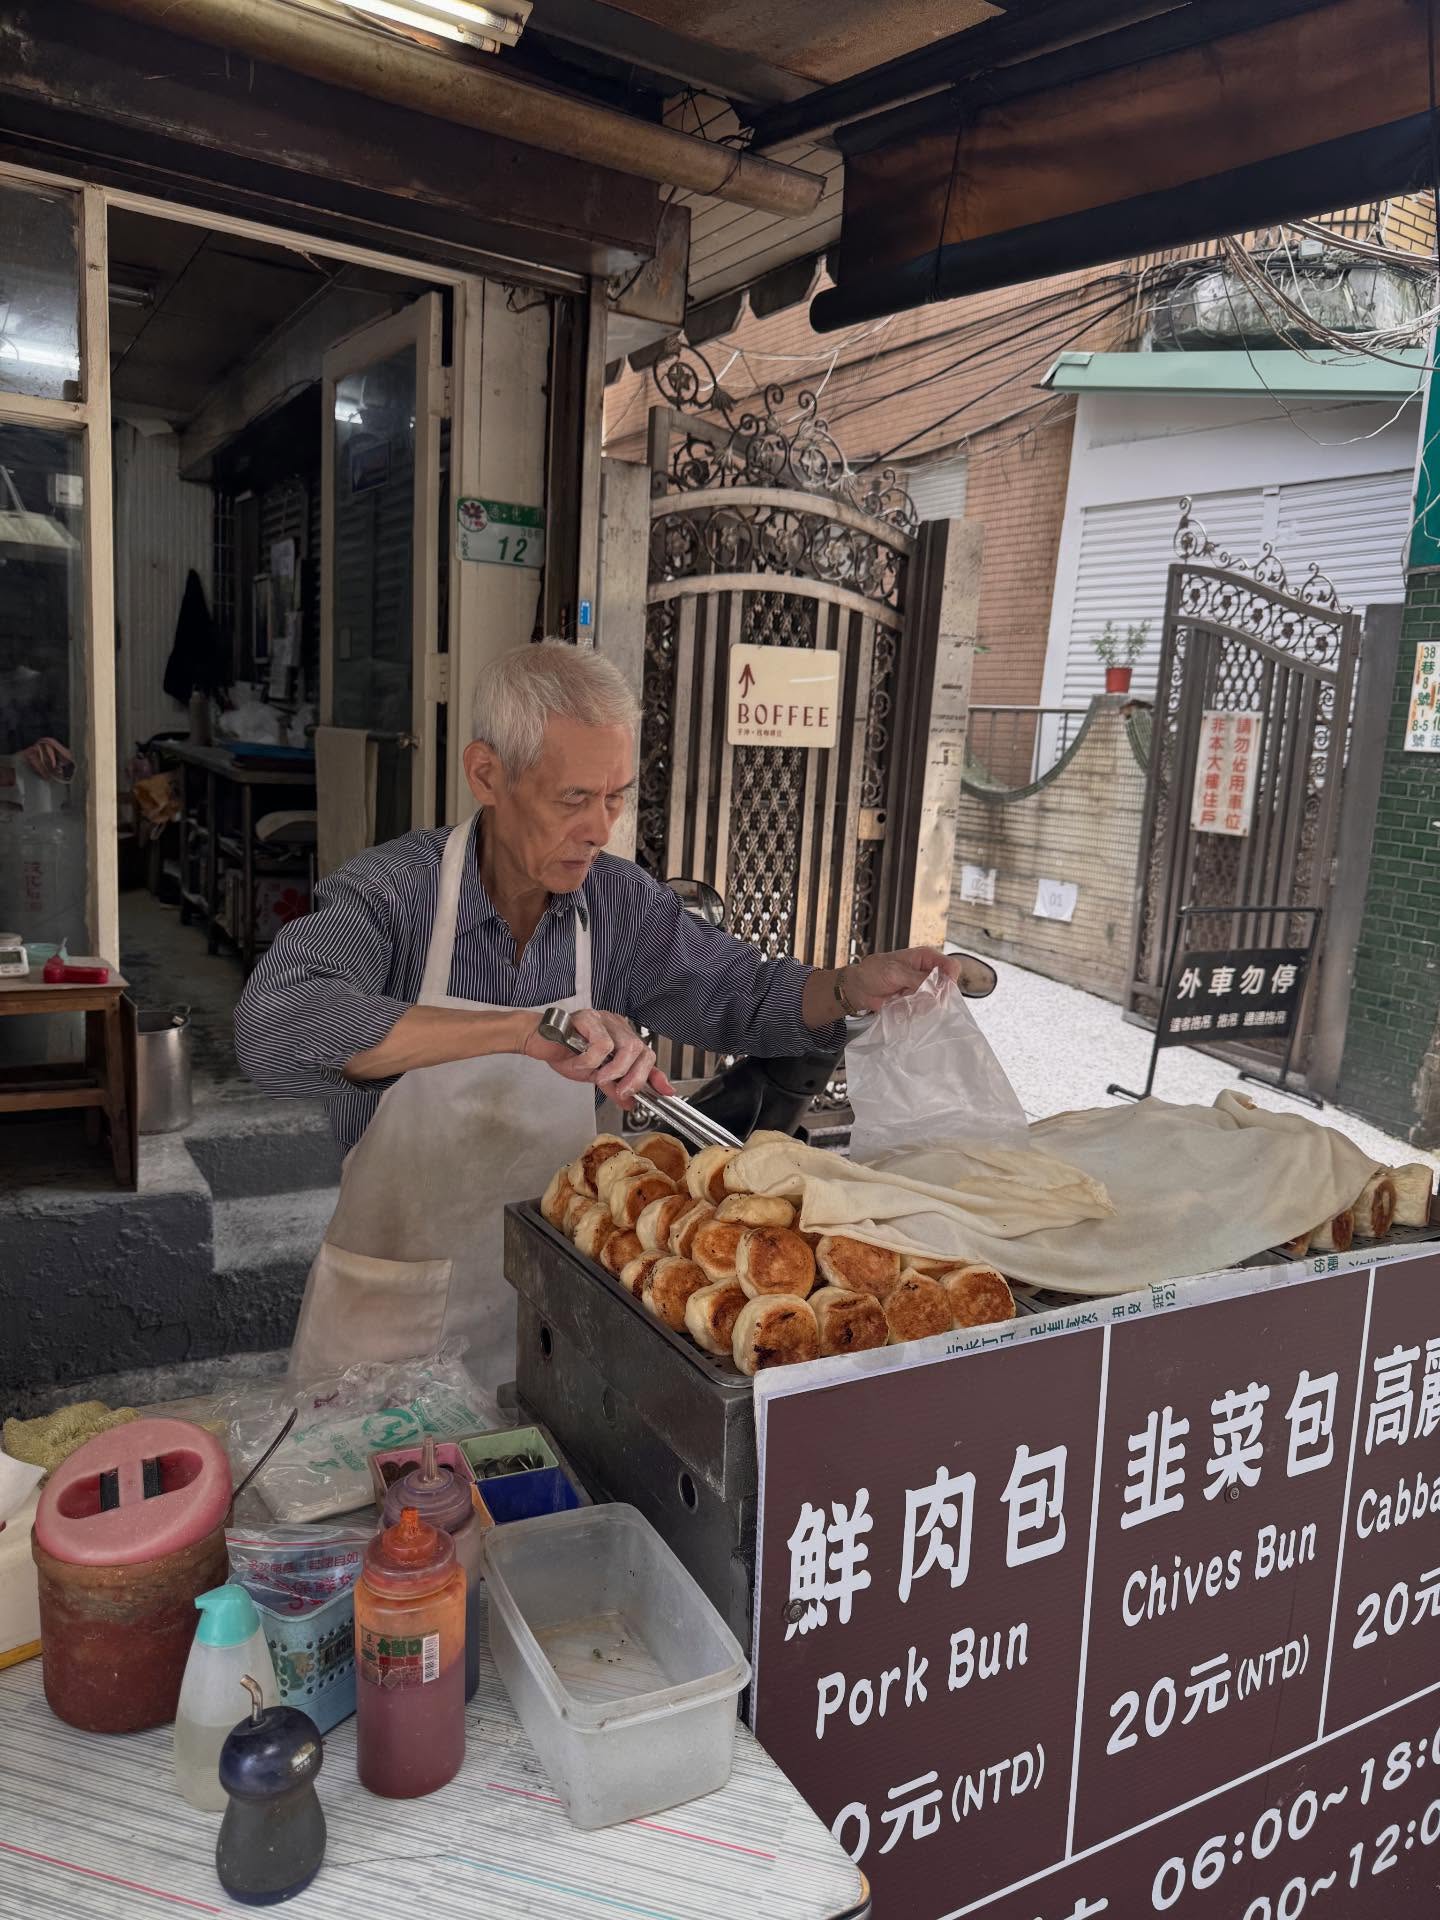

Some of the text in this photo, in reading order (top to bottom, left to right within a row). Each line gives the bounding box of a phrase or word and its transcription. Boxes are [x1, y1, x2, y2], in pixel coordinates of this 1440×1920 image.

[498, 536, 528, 562] 12
[737, 703, 829, 728] BOFFEE
[1199, 717, 1225, 825] 非本大樓住戶
[1176, 963, 1299, 1000] 外車勿停
[1120, 1369, 1339, 1530] 韭菜包
[784, 1444, 1067, 1642] 鮮肉包
[1122, 1522, 1317, 1627] Chives Bun
[815, 1622, 1029, 1740] Pork Bun
[1151, 1727, 1440, 1911] 06:00~18:
